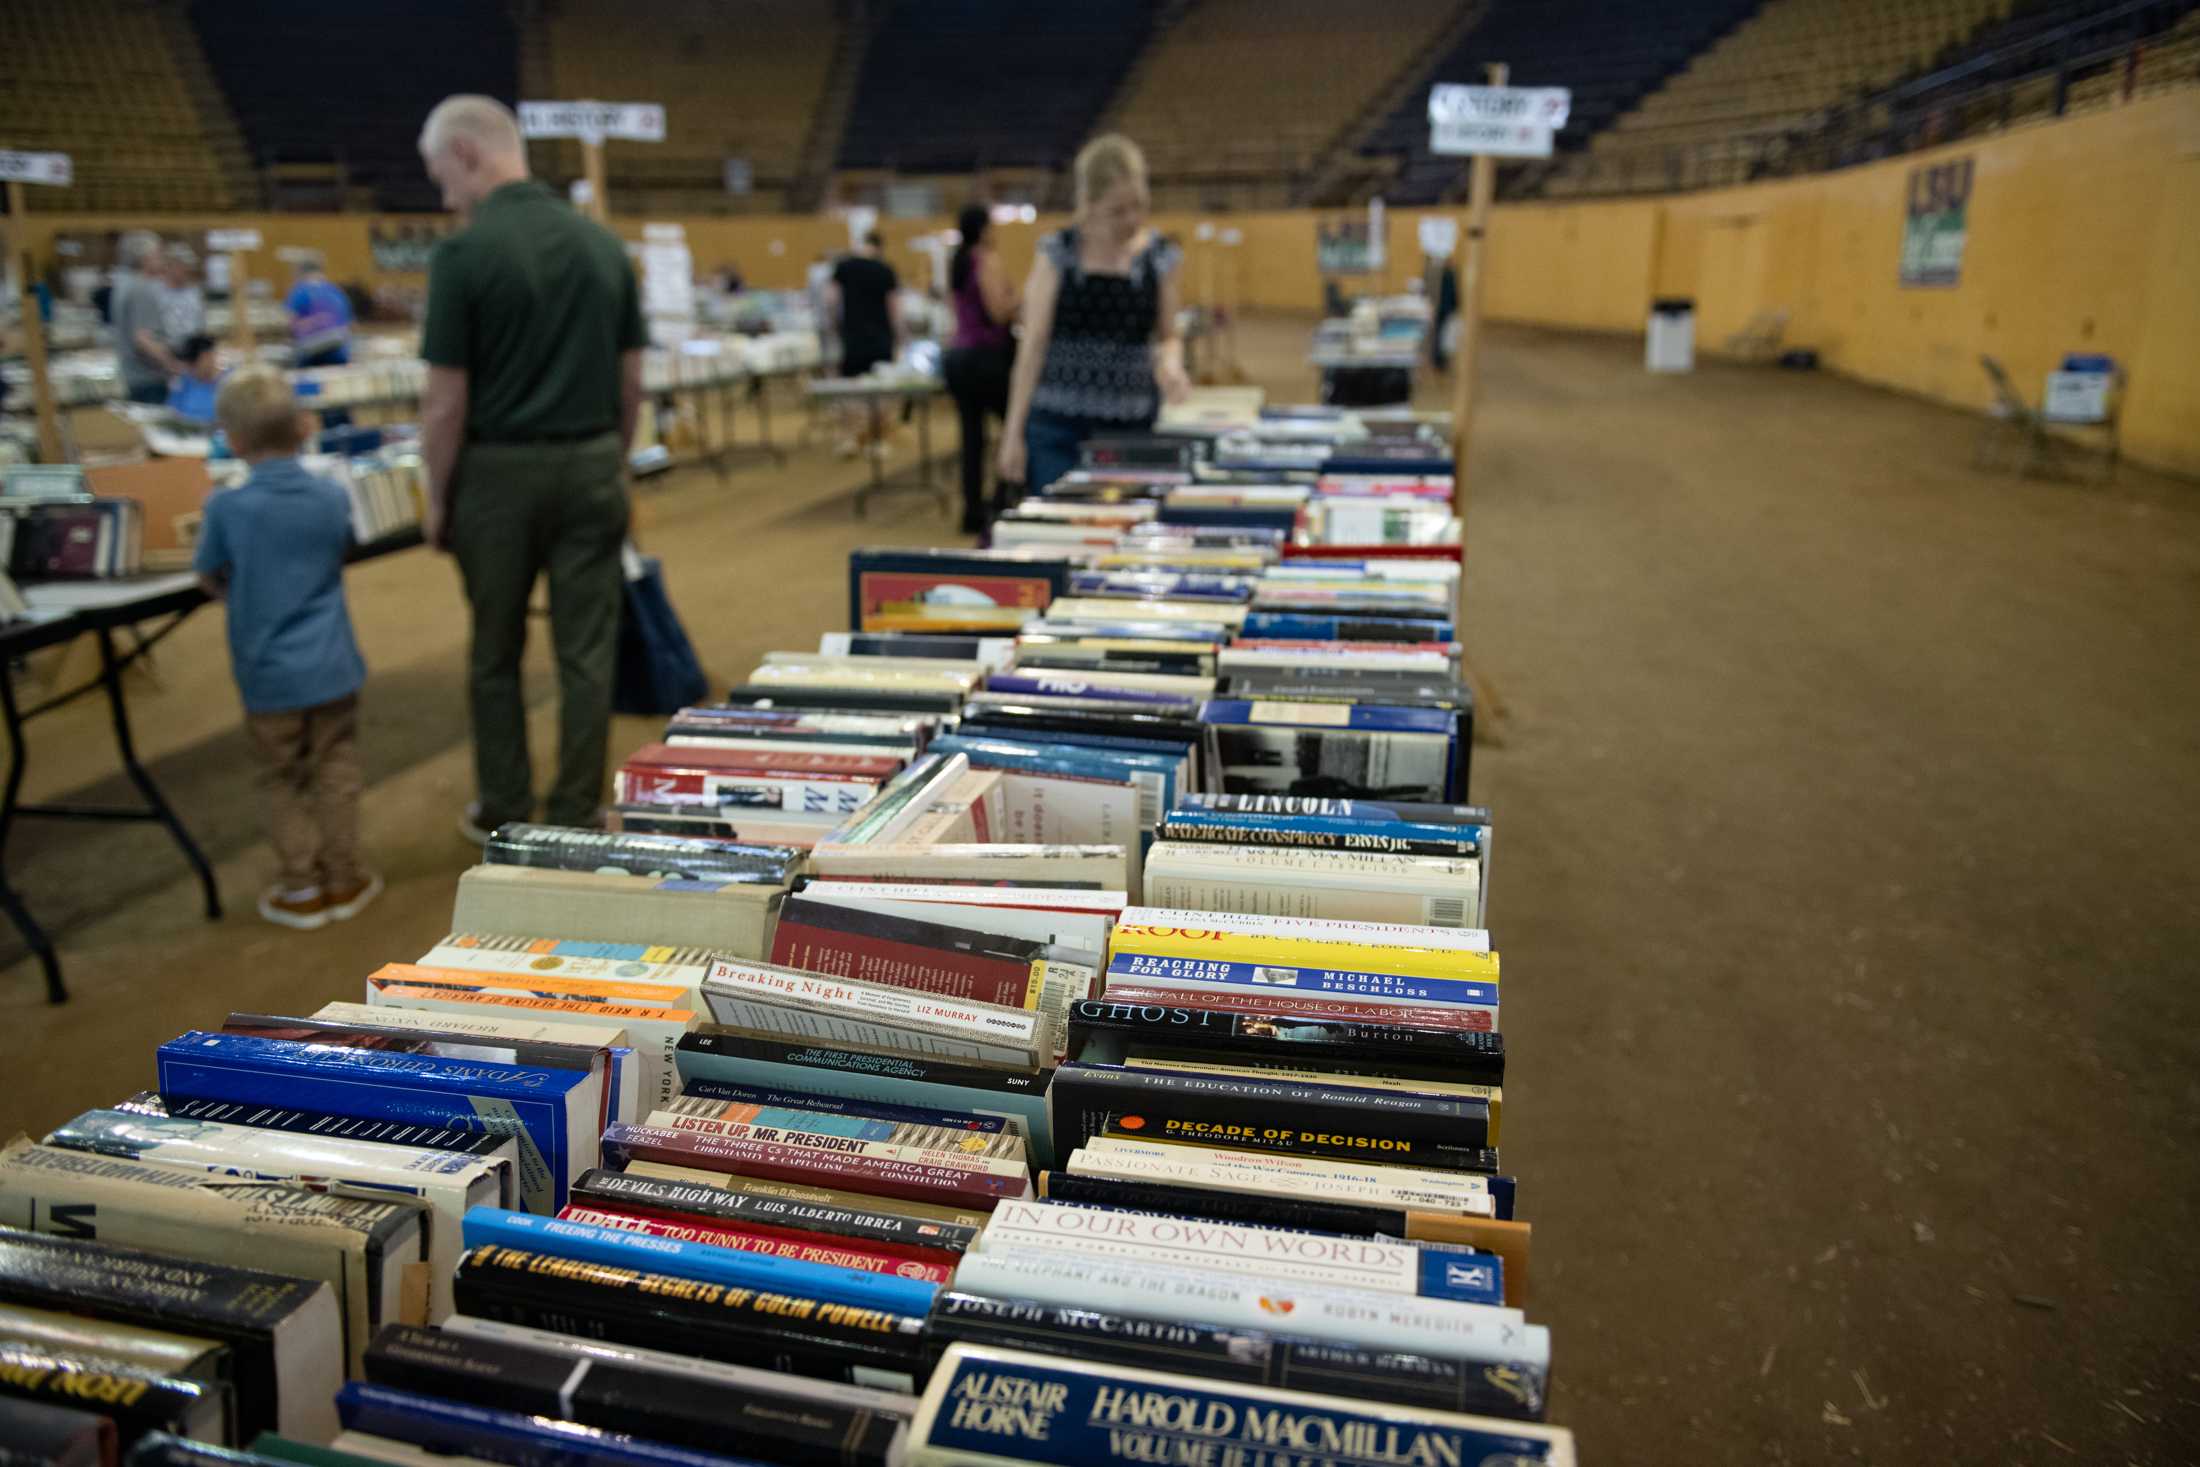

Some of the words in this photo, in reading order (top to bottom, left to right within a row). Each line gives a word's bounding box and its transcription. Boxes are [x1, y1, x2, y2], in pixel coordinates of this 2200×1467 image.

[1238, 794, 1353, 817] LINCOLN
[1250, 829, 1336, 847] CONSPIRACY
[1273, 918, 1320, 927] FIVE
[1326, 920, 1450, 936] PRESIDENTS
[1130, 966, 1162, 975] FOR
[1133, 957, 1231, 973] REACHING
[1172, 970, 1229, 980] GLORY
[716, 965, 796, 993] Breaking
[801, 980, 855, 1001] Night
[1322, 982, 1428, 996] BESCHLOSS
[1324, 972, 1405, 985] MICHAEL
[599, 1006, 633, 1017] REID
[917, 1004, 931, 1014] LIZ
[935, 1007, 978, 1023] MURRAY
[1080, 1001, 1216, 1026] GHOST
[1158, 991, 1198, 1001] FALL
[1201, 995, 1225, 1003] OF
[1231, 997, 1264, 1006] THE
[1269, 1000, 1320, 1011] HOUSE
[1354, 1006, 1415, 1019] LABOR
[699, 1038, 712, 1046] LEE
[1348, 1028, 1414, 1042] Burton
[663, 1035, 675, 1066] NEW
[805, 1048, 823, 1057] THE
[824, 1051, 849, 1061] FIRST
[850, 1054, 914, 1069] PRESIDENTIAL
[443, 1064, 531, 1085] ADAMS
[787, 1053, 881, 1072] COMMUNICATIONS
[883, 1066, 927, 1078] AGENCY
[1007, 1077, 1030, 1087] SUNY
[1083, 1071, 1120, 1081] Evans
[1144, 1078, 1176, 1086] THE
[1185, 1080, 1282, 1096] EDUCATION
[1321, 1092, 1367, 1104] Ronald
[1374, 1097, 1421, 1109] Reagan
[698, 1085, 715, 1093] Carl
[717, 1087, 730, 1096] Van
[732, 1089, 757, 1099] Doren
[767, 1093, 781, 1102] The
[783, 1096, 804, 1105] Great
[806, 1098, 844, 1111] Rehearsal
[176, 1100, 244, 1122] COPS
[246, 1109, 304, 1129] AND
[625, 1125, 680, 1140] HUCKABEE
[626, 1133, 663, 1146] FEAZEL
[672, 1115, 727, 1136] LISTEN
[728, 1124, 750, 1140] UP,
[753, 1127, 781, 1143] MR.
[784, 1132, 869, 1154] PRESIDENT
[1166, 1120, 1255, 1138] DECADE
[1263, 1129, 1293, 1140] OF
[1300, 1132, 1411, 1152] DECISION
[1180, 1131, 1248, 1141] THEODORE
[1253, 1137, 1294, 1147] MITAU
[693, 1144, 763, 1161] CHRISTIANITY
[780, 1156, 842, 1172] CAPITALISM
[880, 1171, 959, 1188] CONSTITUTION
[695, 1135, 721, 1147] THE
[723, 1139, 764, 1151] THREE
[786, 1147, 825, 1160] THAT
[829, 1155, 864, 1167] MADE
[867, 1158, 924, 1175] AMERICA
[927, 1166, 971, 1180] GREAT
[918, 1157, 944, 1167] CRAIG
[945, 1159, 989, 1172] CRAWFORD
[921, 1150, 946, 1159] HELEN
[950, 1152, 980, 1164] THOMAS
[1080, 1154, 1200, 1177] PASSIONATE
[1210, 1168, 1264, 1184] SAGE
[1214, 1151, 1262, 1164] Woodrow
[1263, 1156, 1302, 1169] Wilson
[744, 1183, 778, 1195] Franklin
[788, 1189, 833, 1203] Roosevelt
[668, 1187, 749, 1209] HIGHWAY
[754, 1200, 786, 1213] LUIS
[789, 1205, 853, 1222] ALBERTO
[854, 1215, 903, 1232] URREA
[506, 1215, 534, 1228] COOK
[543, 1222, 597, 1241] FREEING
[597, 1230, 620, 1245] THE
[623, 1235, 684, 1254] PRESSES
[567, 1208, 653, 1236] UDALL
[664, 1226, 696, 1242] TOO
[696, 1230, 752, 1249] FUNNY
[752, 1239, 775, 1254] TO
[776, 1243, 799, 1257] BE
[800, 1247, 889, 1273] PRESIDENT
[993, 1232, 1063, 1245] SENATOR
[1075, 1243, 1138, 1256] ROBERT
[1003, 1205, 1044, 1226] IN
[1056, 1212, 1136, 1238] OUR
[1151, 1223, 1248, 1250] OWN
[1263, 1235, 1405, 1266] WORDS
[493, 1249, 533, 1271] THE
[528, 1254, 641, 1288] LEADERSHIP
[638, 1274, 726, 1304] SECRETS
[724, 1287, 753, 1309] OF
[753, 1291, 818, 1320] COLIN
[816, 1302, 898, 1333] POWELL
[1016, 1264, 1093, 1281] ELEPHANT
[1100, 1273, 1131, 1288] AND
[1139, 1279, 1167, 1294] THE
[1175, 1284, 1241, 1303] DRAGON
[946, 1298, 1043, 1323] JOSEPH
[1323, 1303, 1379, 1321] ROBYN
[1391, 1313, 1475, 1334] MEREDITH
[953, 1371, 1069, 1414] ALISTAIR
[951, 1399, 1052, 1441] HORNE
[1090, 1385, 1236, 1437] HAROLD
[1240, 1406, 1462, 1467] MACMILLAN
[1109, 1429, 1219, 1467] VOLUME
